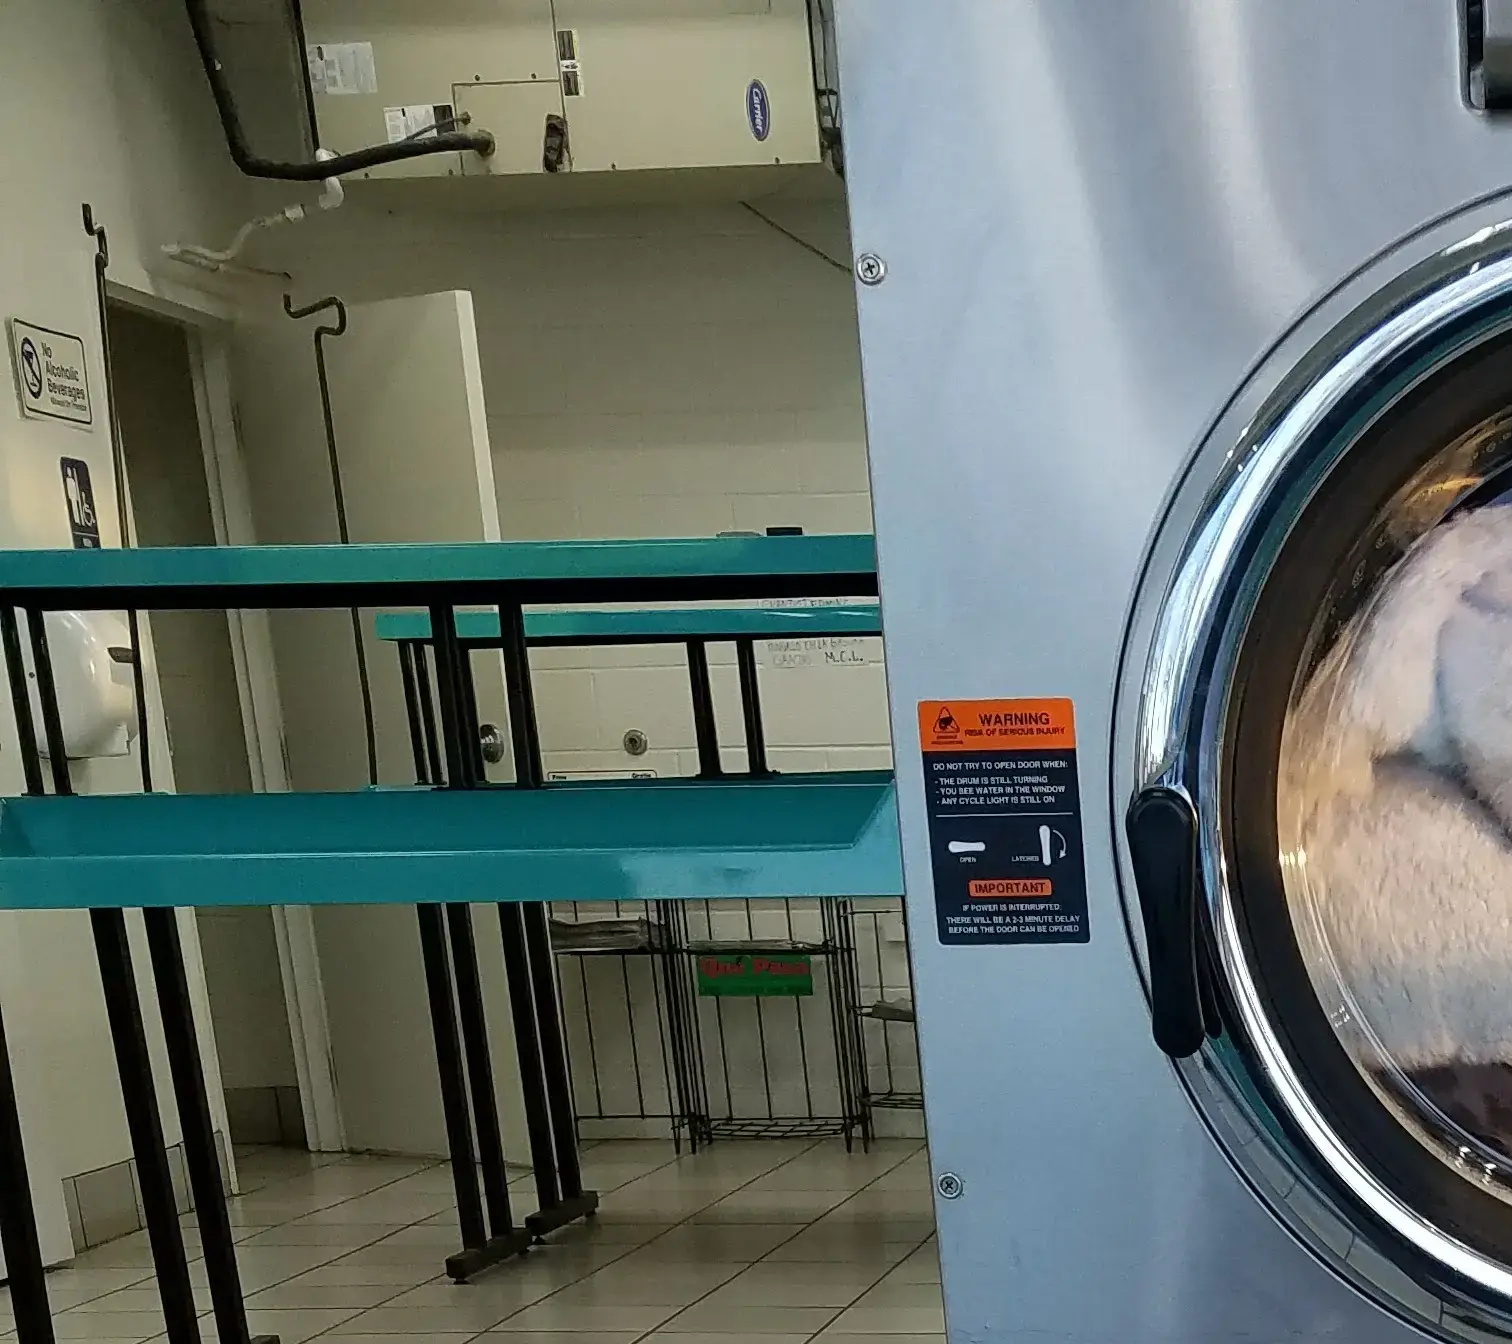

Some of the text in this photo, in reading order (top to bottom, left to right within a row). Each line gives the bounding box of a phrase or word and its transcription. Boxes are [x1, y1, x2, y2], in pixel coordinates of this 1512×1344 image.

[752, 88, 763, 132] Carrier
[41, 341, 52, 358] No
[46, 360, 79, 381] Alcoholic
[47, 378, 85, 401] Beverages
[979, 712, 1050, 726] WARNING
[965, 727, 1065, 736] RISK OF SERIOUS INJURY
[933, 763, 945, 771] DO
[946, 762, 963, 770] NOT
[964, 762, 980, 770] TRY
[981, 762, 993, 770] TO
[994, 761, 1016, 769] OPEN
[1017, 761, 1041, 769] DOOR
[939, 777, 955, 785] THE
[956, 777, 979, 785] DRUM
[990, 776, 1012, 784] STILL
[1012, 775, 1048, 784] TURNING
[958, 787, 974, 795] SEE
[975, 786, 1003, 794] WATER
[1031, 785, 1066, 793] WINDOW
[941, 797, 958, 805] ANY
[958, 797, 985, 805] CYCLE
[986, 796, 1009, 805] LIGHT
[1010, 796, 1019, 804] IS
[1042, 795, 1056, 803] ON
[974, 882, 1046, 894] IMPORTANT
[962, 904, 969, 912] IF
[971, 904, 998, 912] POWER
[946, 916, 972, 924] THERE
[973, 916, 992, 924] WILL
[993, 916, 1003, 924] BE
[1024, 915, 1053, 923] MINUTE
[1054, 915, 1080, 923] DELAY
[948, 926, 979, 934] BEFORE
[996, 925, 1018, 933] DOOR
[1019, 925, 1035, 933] CAN
[1037, 925, 1047, 933] BE
[1048, 924, 1080, 932] OPENED
